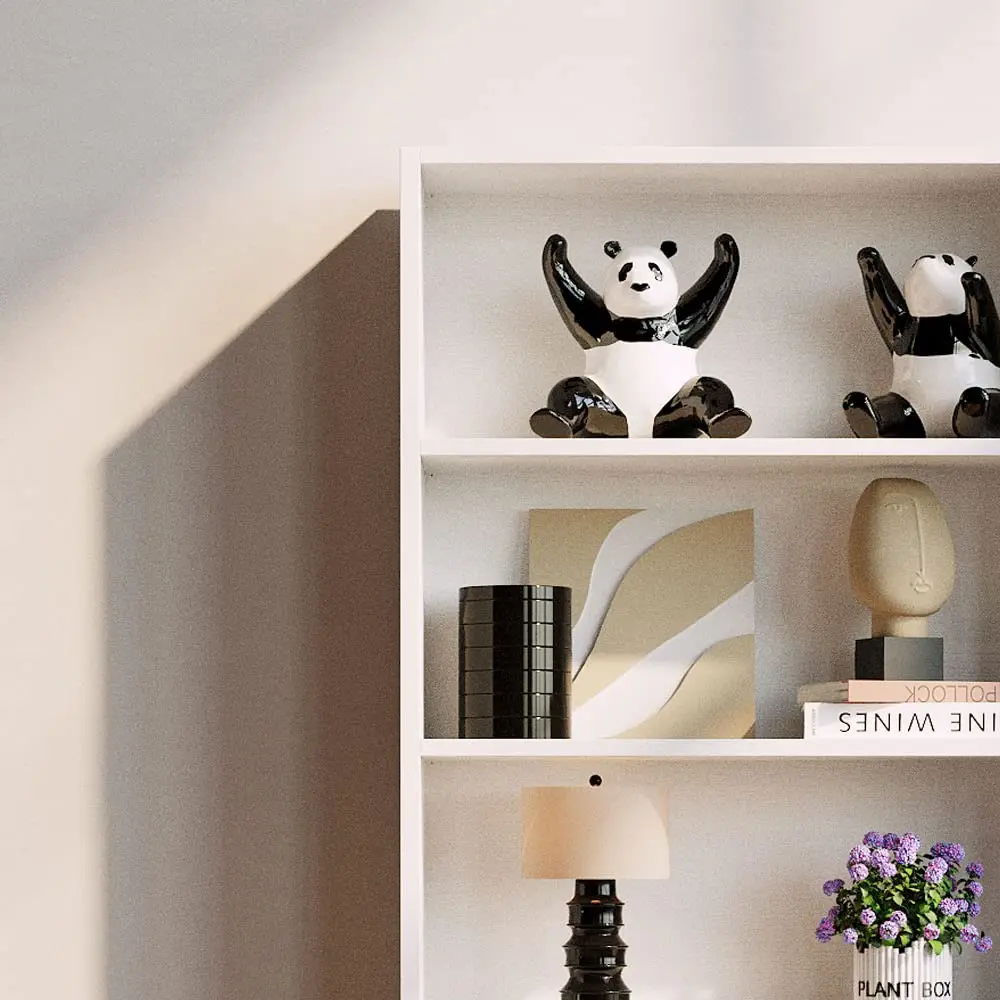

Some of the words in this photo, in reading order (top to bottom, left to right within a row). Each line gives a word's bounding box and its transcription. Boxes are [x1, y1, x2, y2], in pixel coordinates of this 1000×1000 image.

[905, 685, 996, 703] POLLOCK
[838, 712, 935, 732] WINES
[858, 981, 914, 998] PLANT
[922, 981, 951, 998] BOX
